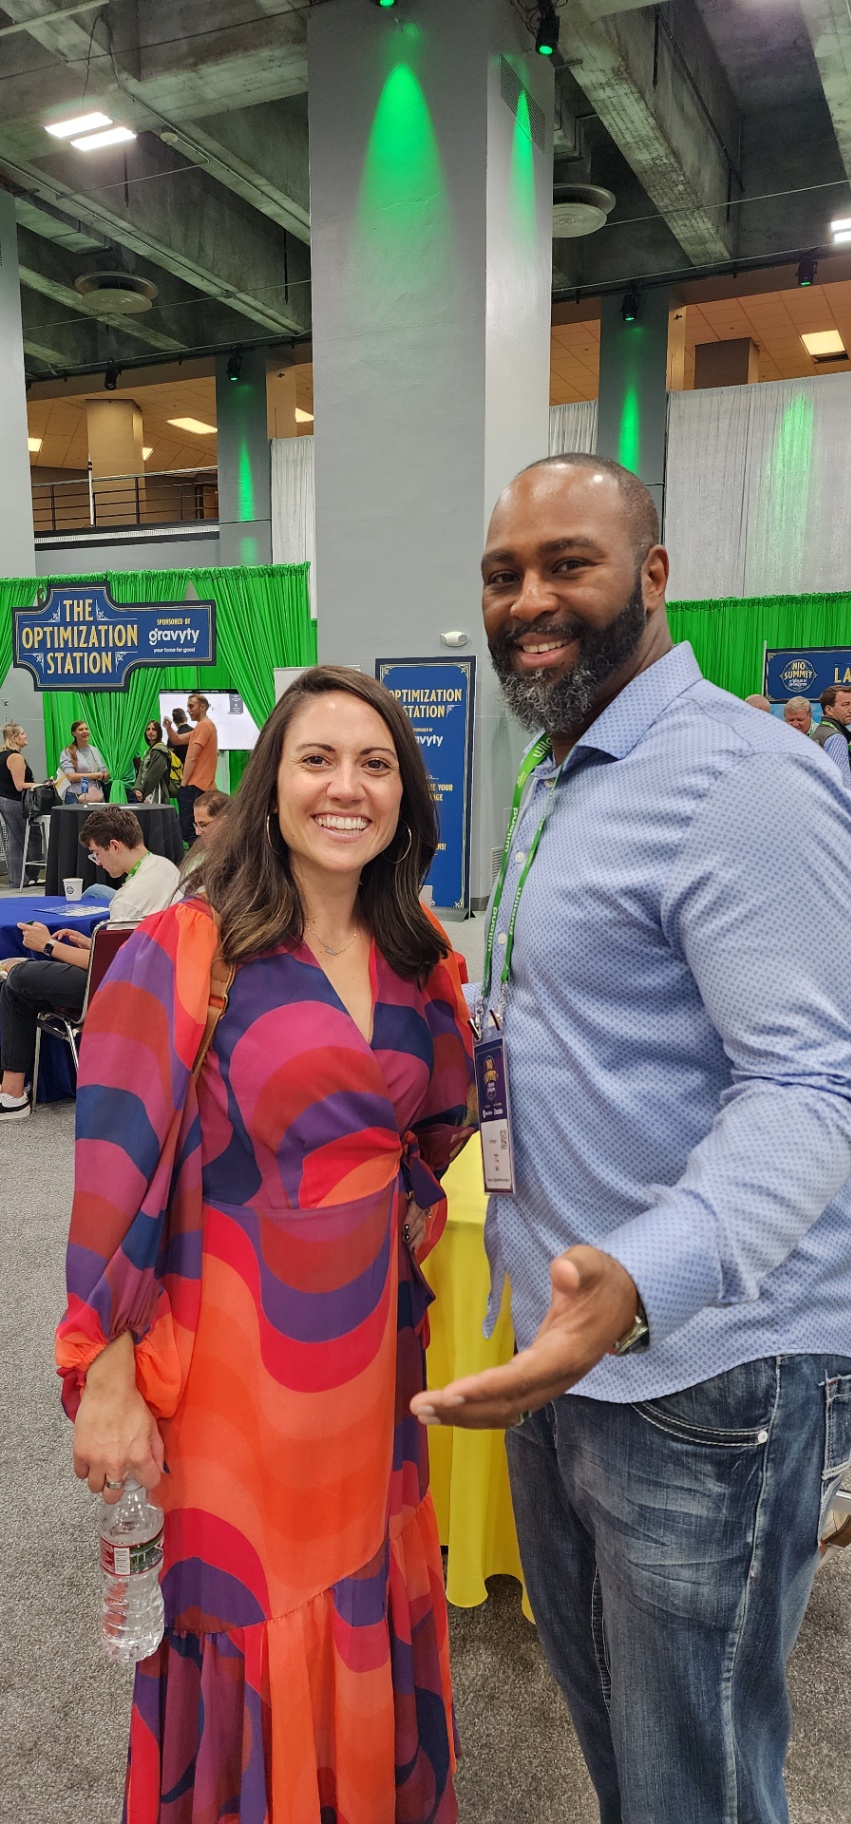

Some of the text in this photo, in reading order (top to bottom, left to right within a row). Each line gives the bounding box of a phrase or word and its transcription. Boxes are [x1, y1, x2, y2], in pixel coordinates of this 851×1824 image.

[64, 599, 93, 621] THE
[22, 625, 138, 648] OPTIMIZATION
[148, 628, 200, 645] gravyty
[46, 652, 112, 674] STATION
[792, 662, 806, 670] NIO
[784, 669, 812, 680] SUMMIT
[414, 734, 444, 747] vyty
[532, 737, 552, 758] wila
[437, 783, 453, 791] YOUR
[504, 807, 518, 852] wiland
[487, 906, 498, 952] wiland
